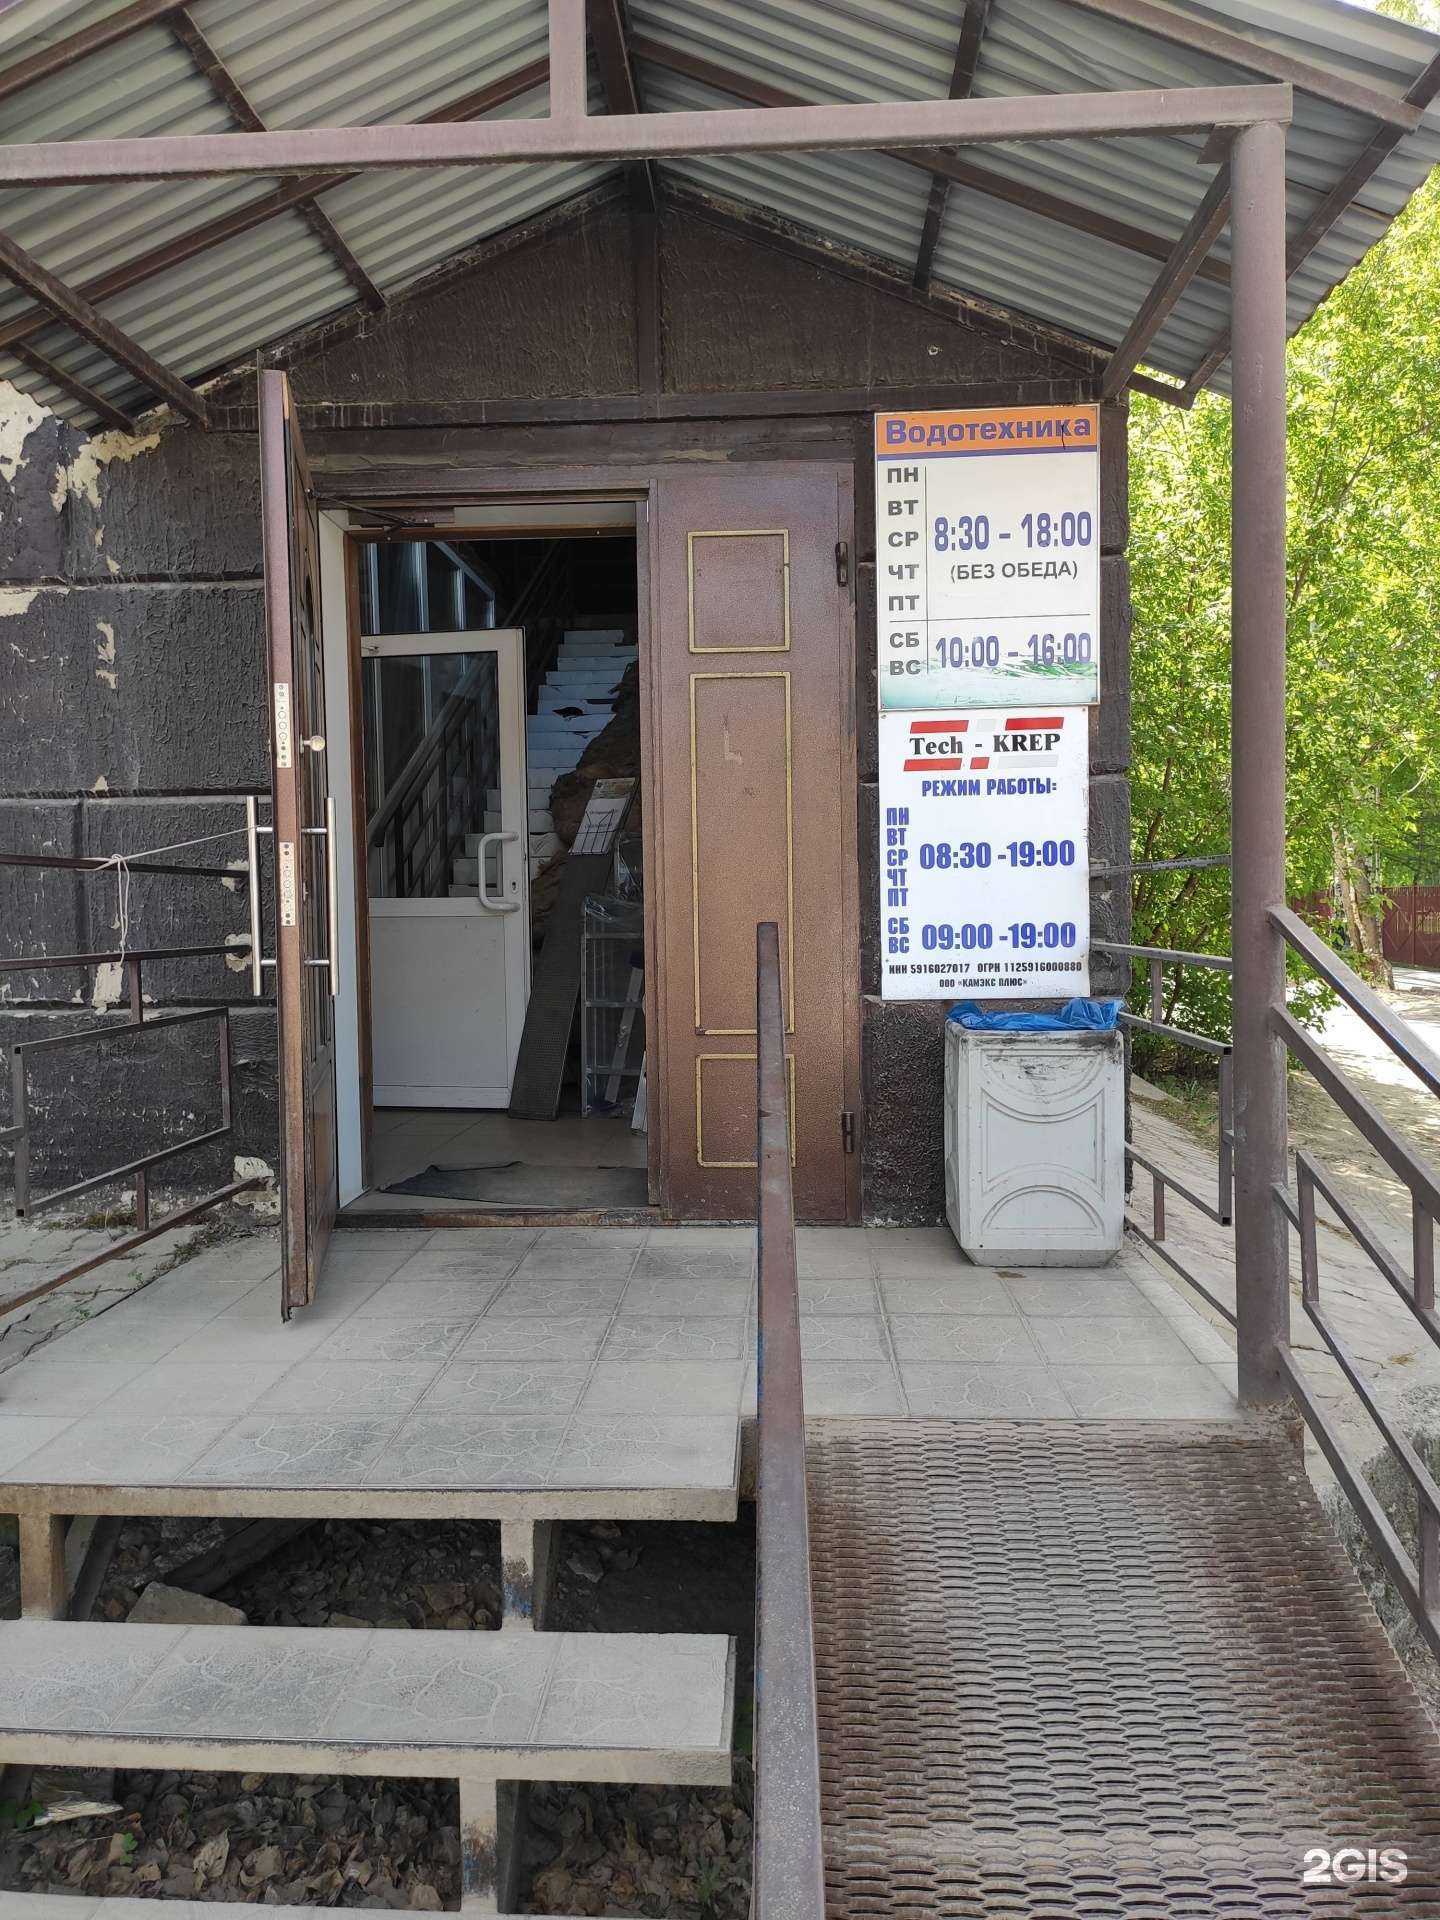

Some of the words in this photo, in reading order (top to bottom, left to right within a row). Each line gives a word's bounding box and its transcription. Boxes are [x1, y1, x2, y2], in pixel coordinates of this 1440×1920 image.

[886, 418, 1090, 446] Водотехника
[887, 467, 919, 483] ПН
[887, 500, 918, 516] ВТ
[888, 531, 919, 547] СР
[934, 515, 989, 551] 8:30
[1021, 511, 1091, 548] 18:00
[888, 564, 919, 580] ЧТ
[950, 563, 995, 583] (БЕЗ
[1002, 561, 1078, 580] ОБЕДА)
[888, 595, 920, 611] ПТ
[889, 632, 919, 648] СБ
[935, 635, 999, 668] 10:00
[1027, 632, 1091, 666] 16:00
[889, 660, 921, 675] ВС
[909, 735, 963, 755] Tech
[993, 733, 1061, 753] KREP
[922, 779, 981, 797] РЕЖИМ
[987, 777, 1057, 796] РАБОТЫ:
[886, 807, 909, 826] ПН
[886, 828, 907, 846] ВТ
[887, 848, 909, 866] СР
[920, 842, 991, 869] 08:30
[887, 868, 907, 886] ЧТ
[887, 888, 908, 906] ПТ
[888, 917, 910, 934] СБ
[888, 936, 910, 954] ВС
[922, 923, 993, 950] 09:00
[977, 963, 1000, 972] ОГРН
[939, 979, 955, 987] ООО
